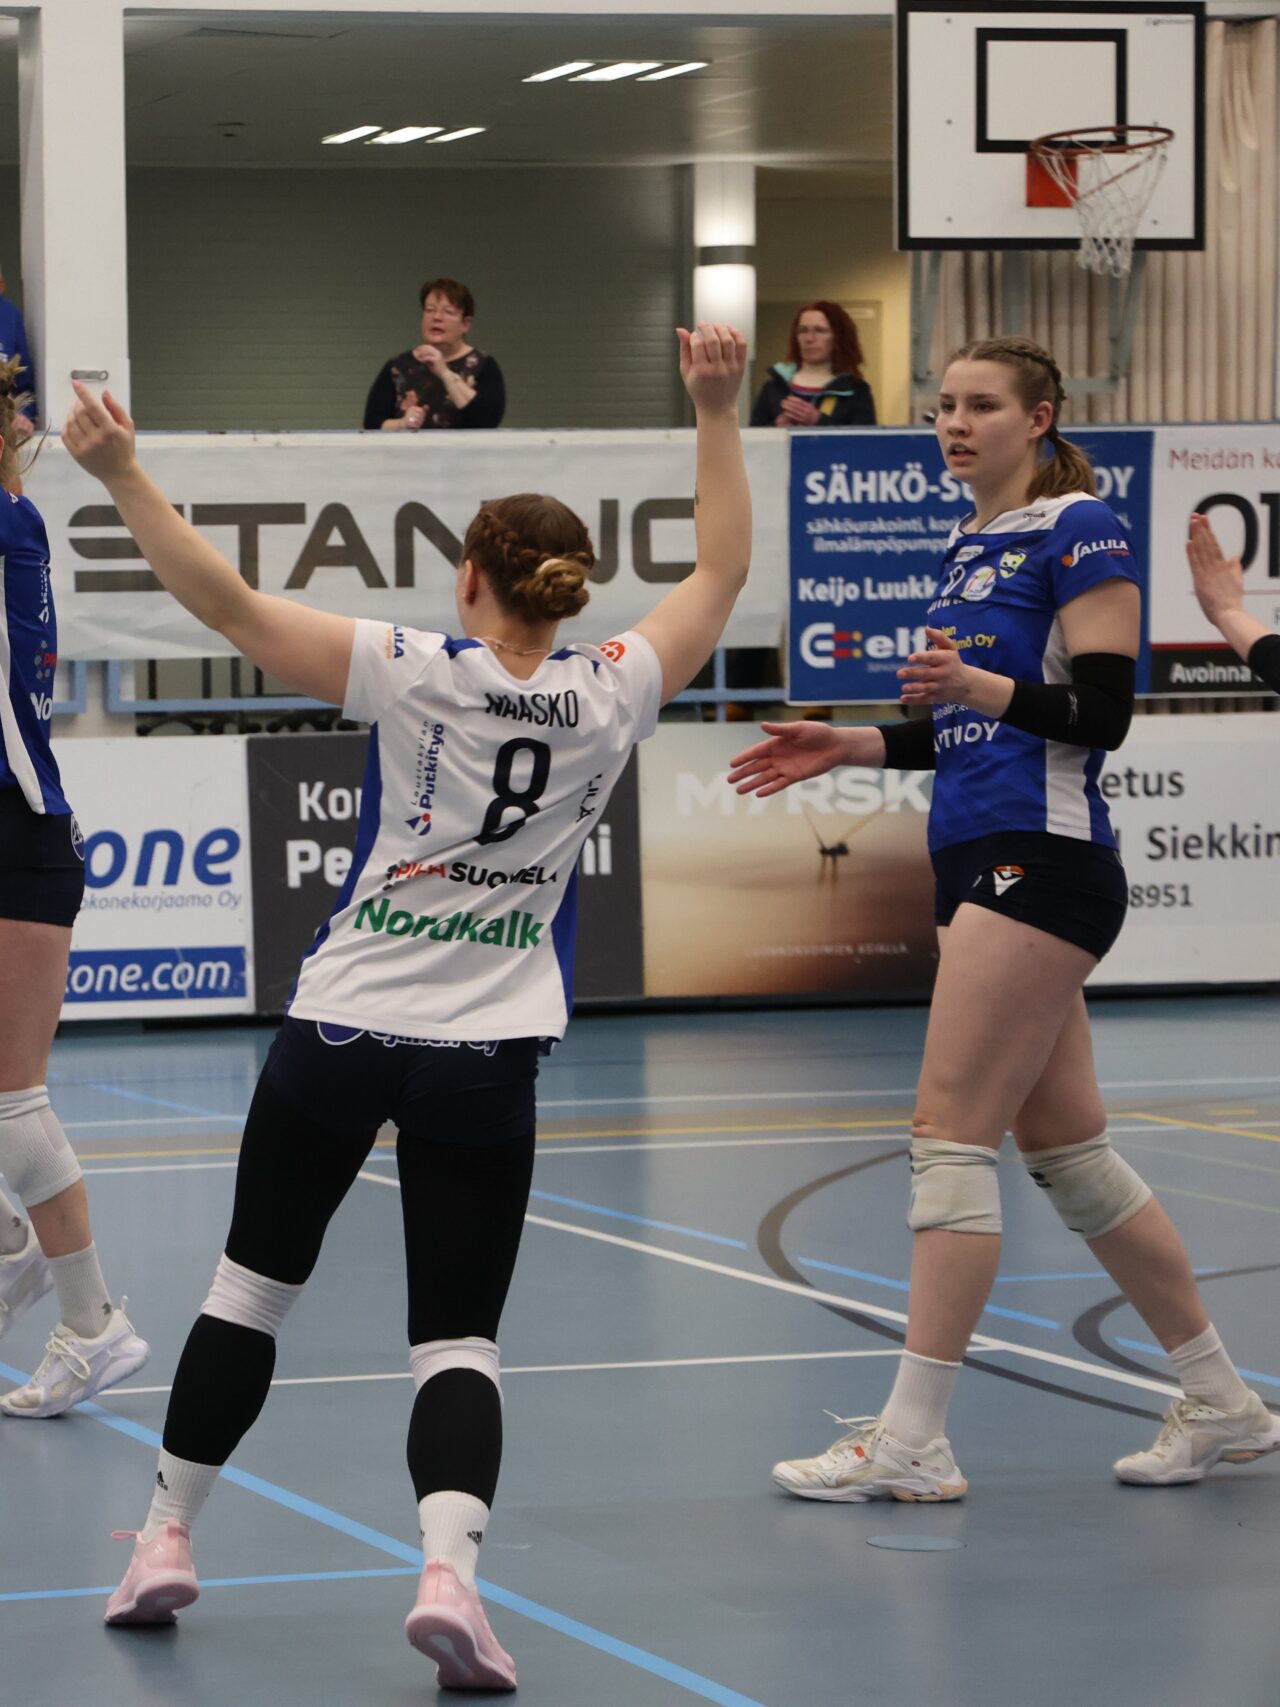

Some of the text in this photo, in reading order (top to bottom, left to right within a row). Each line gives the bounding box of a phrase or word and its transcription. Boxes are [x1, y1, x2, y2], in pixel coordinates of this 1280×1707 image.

[1170, 449, 1255, 472] Meidän
[798, 574, 938, 607] Keijo Luukk
[1171, 661, 1252, 684] Avoinna
[963, 721, 1000, 743] OY
[419, 723, 445, 810] Putkityö
[1101, 766, 1185, 798] etus
[473, 737, 551, 847] 8
[217, 889, 242, 910] Oy
[353, 897, 545, 950] Nordkalk
[64, 960, 232, 994] one.com
